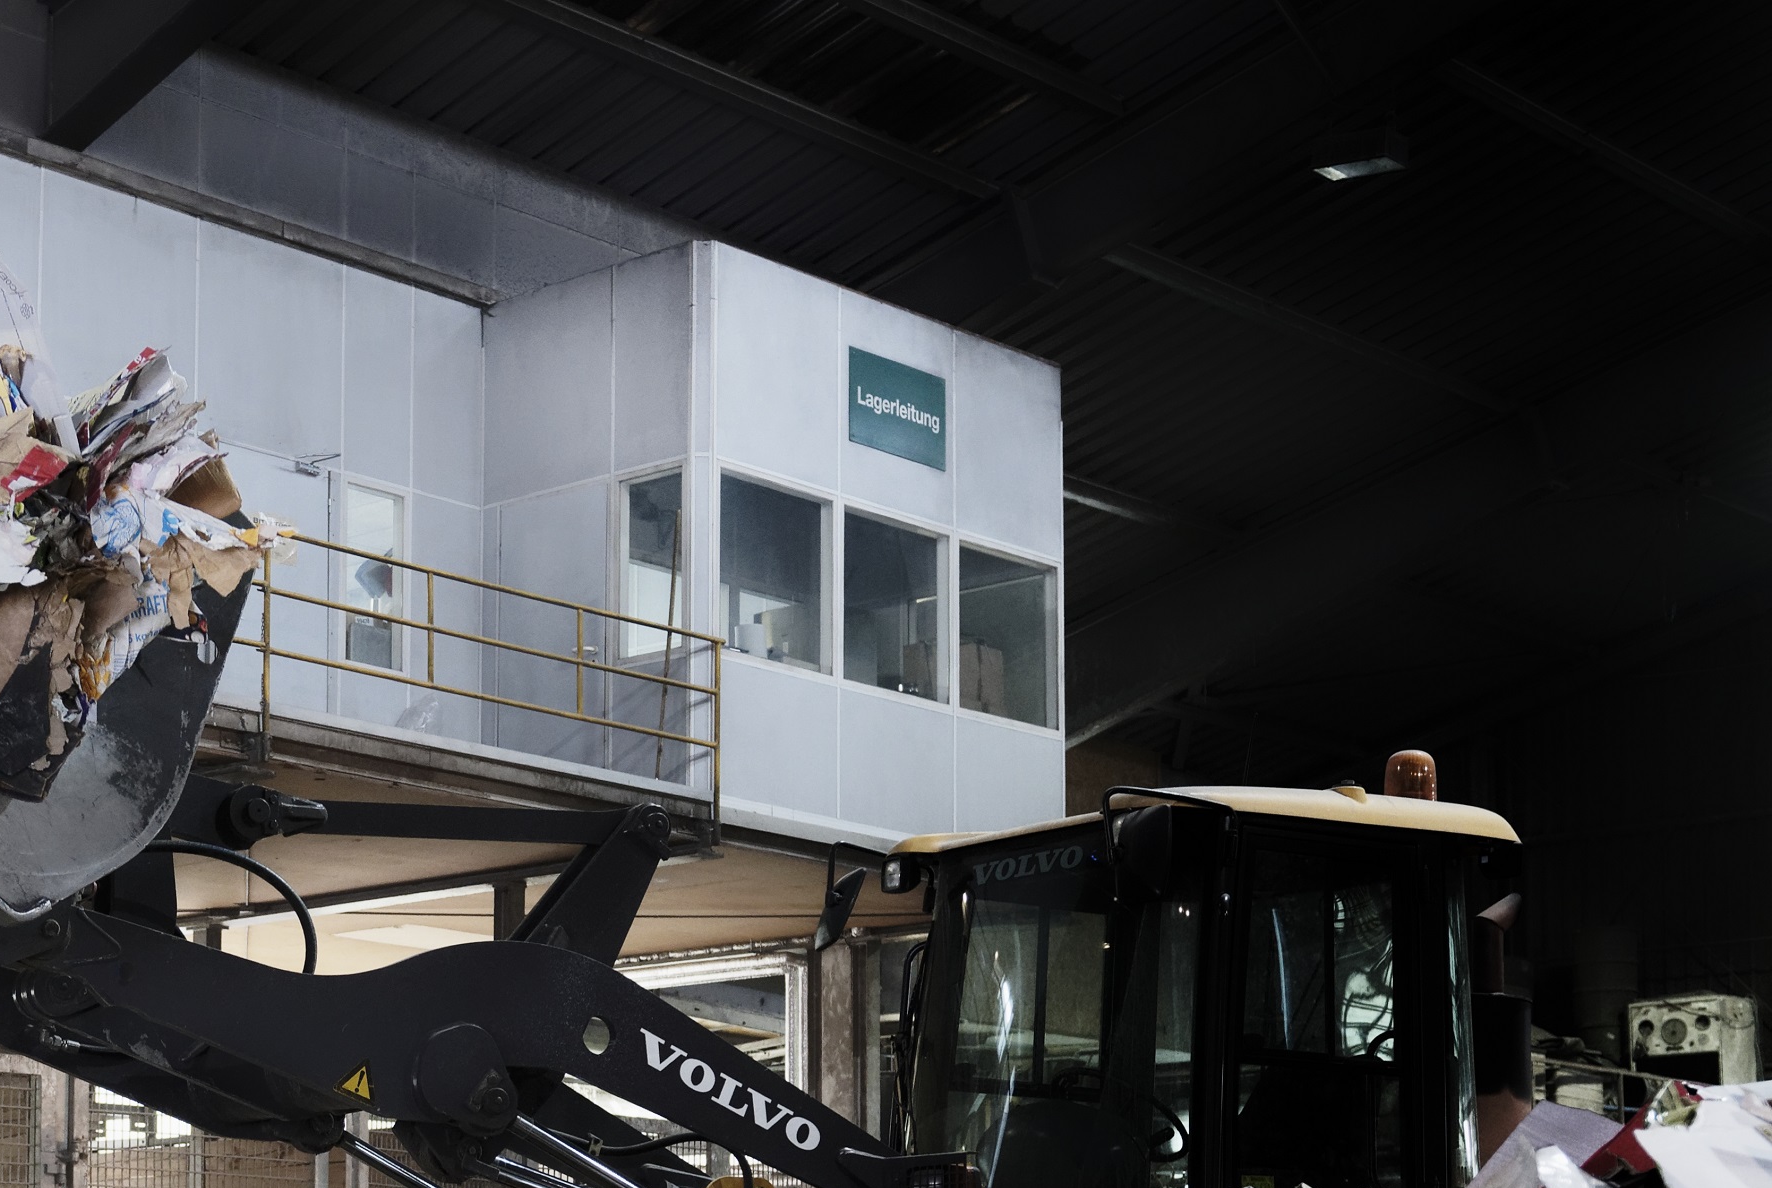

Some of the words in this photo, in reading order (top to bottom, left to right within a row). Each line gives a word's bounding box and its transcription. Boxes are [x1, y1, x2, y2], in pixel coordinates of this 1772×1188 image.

[856, 385, 941, 434] Lagerleitung
[972, 844, 1084, 886] VOLVO
[638, 1027, 822, 1153] VOLVO
